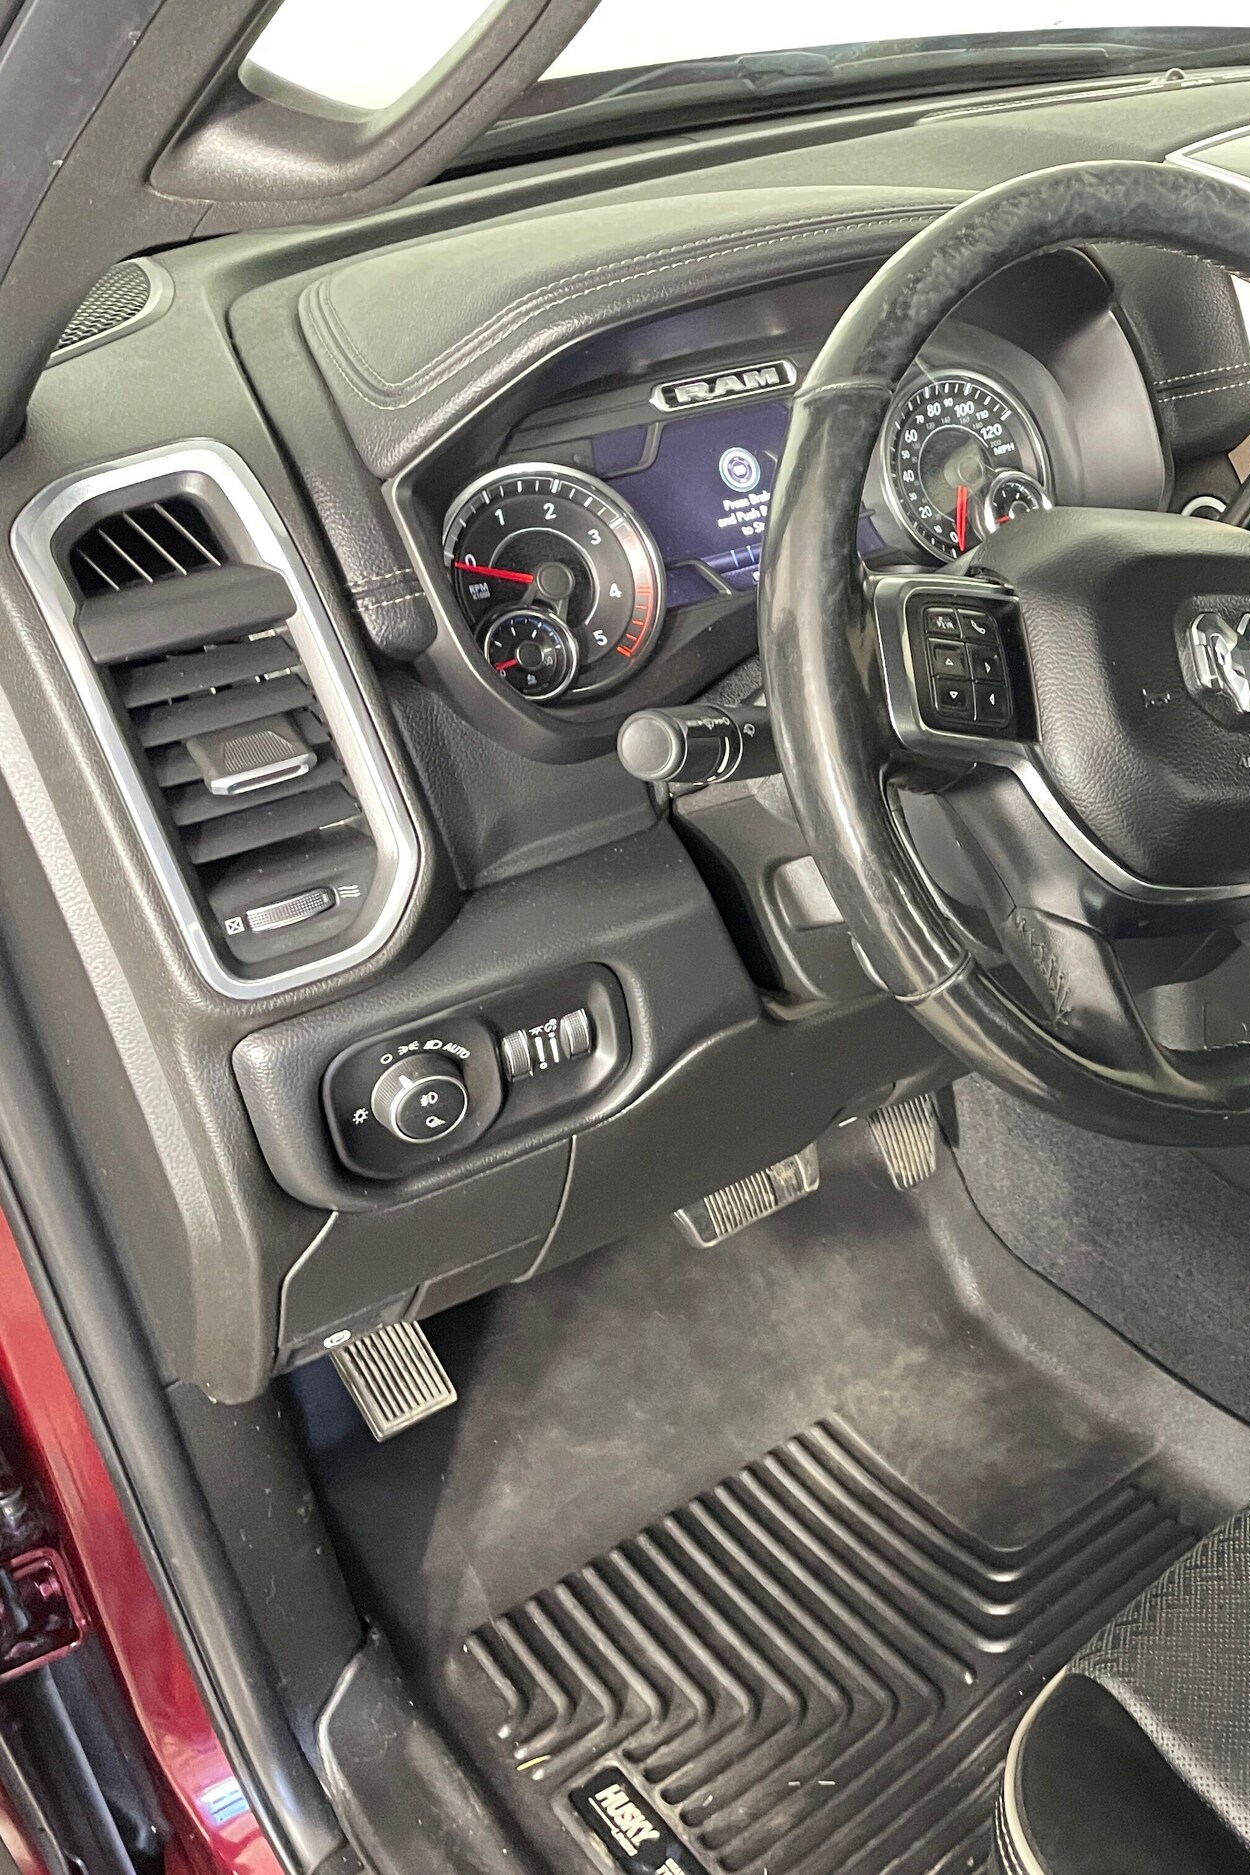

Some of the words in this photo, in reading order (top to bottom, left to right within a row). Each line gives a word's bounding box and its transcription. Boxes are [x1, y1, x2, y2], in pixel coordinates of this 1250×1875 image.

[674, 368, 780, 403] RAM
[943, 398, 953, 408] 90
[954, 401, 975, 418] 100
[927, 403, 941, 418] 80
[975, 410, 989, 421] 110
[915, 415, 925, 424] 70
[905, 429, 918, 443] 60
[980, 423, 1002, 440] 120
[901, 450, 910, 460] 50
[993, 443, 1015, 456] MPH
[903, 470, 915, 483] 40
[544, 503, 556, 520] 2
[723, 498, 750, 511] Press
[494, 508, 505, 525] 1
[717, 513, 737, 528] and
[736, 508, 760, 523] Push
[919, 506, 932, 519] 20
[588, 529, 601, 545] 3
[741, 526, 754, 536] to
[950, 531, 959, 543] 0
[469, 583, 489, 594] RPM
[609, 583, 622, 598] 4
[593, 630, 608, 646] 5
[442, 1042, 471, 1059] AUTO
[594, 1783, 660, 1846] HUSKY
